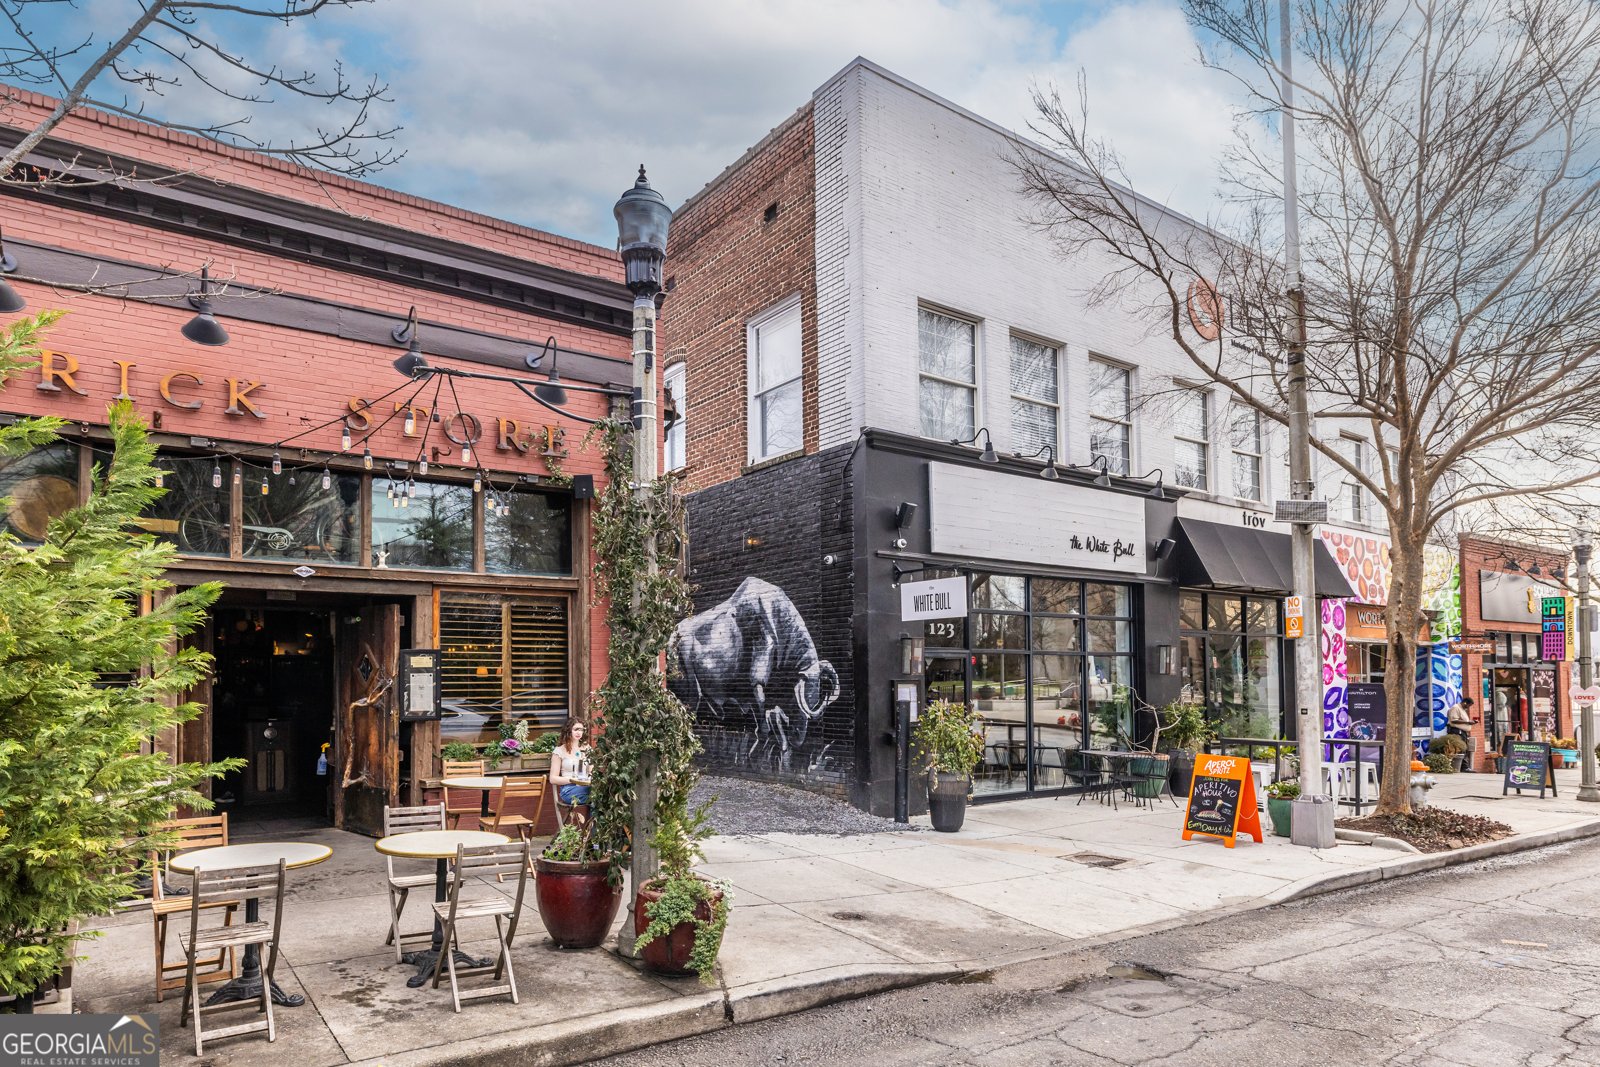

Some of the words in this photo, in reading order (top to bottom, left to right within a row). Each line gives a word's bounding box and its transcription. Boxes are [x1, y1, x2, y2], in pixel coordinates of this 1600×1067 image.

[36, 349, 267, 419] RICK
[347, 398, 568, 458] STORE
[1069, 535, 1083, 550] the
[1086, 536, 1110, 553] White
[1113, 538, 1135, 562] Bull
[913, 594, 933, 612] WHITE
[935, 592, 951, 610] BULL
[1287, 597, 1300, 607] NO
[929, 623, 955, 638] 123
[1204, 759, 1236, 770] APEROL
[1209, 767, 1231, 775] SPRITZ
[1194, 782, 1237, 797] APERITIVO
[1202, 789, 1223, 797] HOUR
